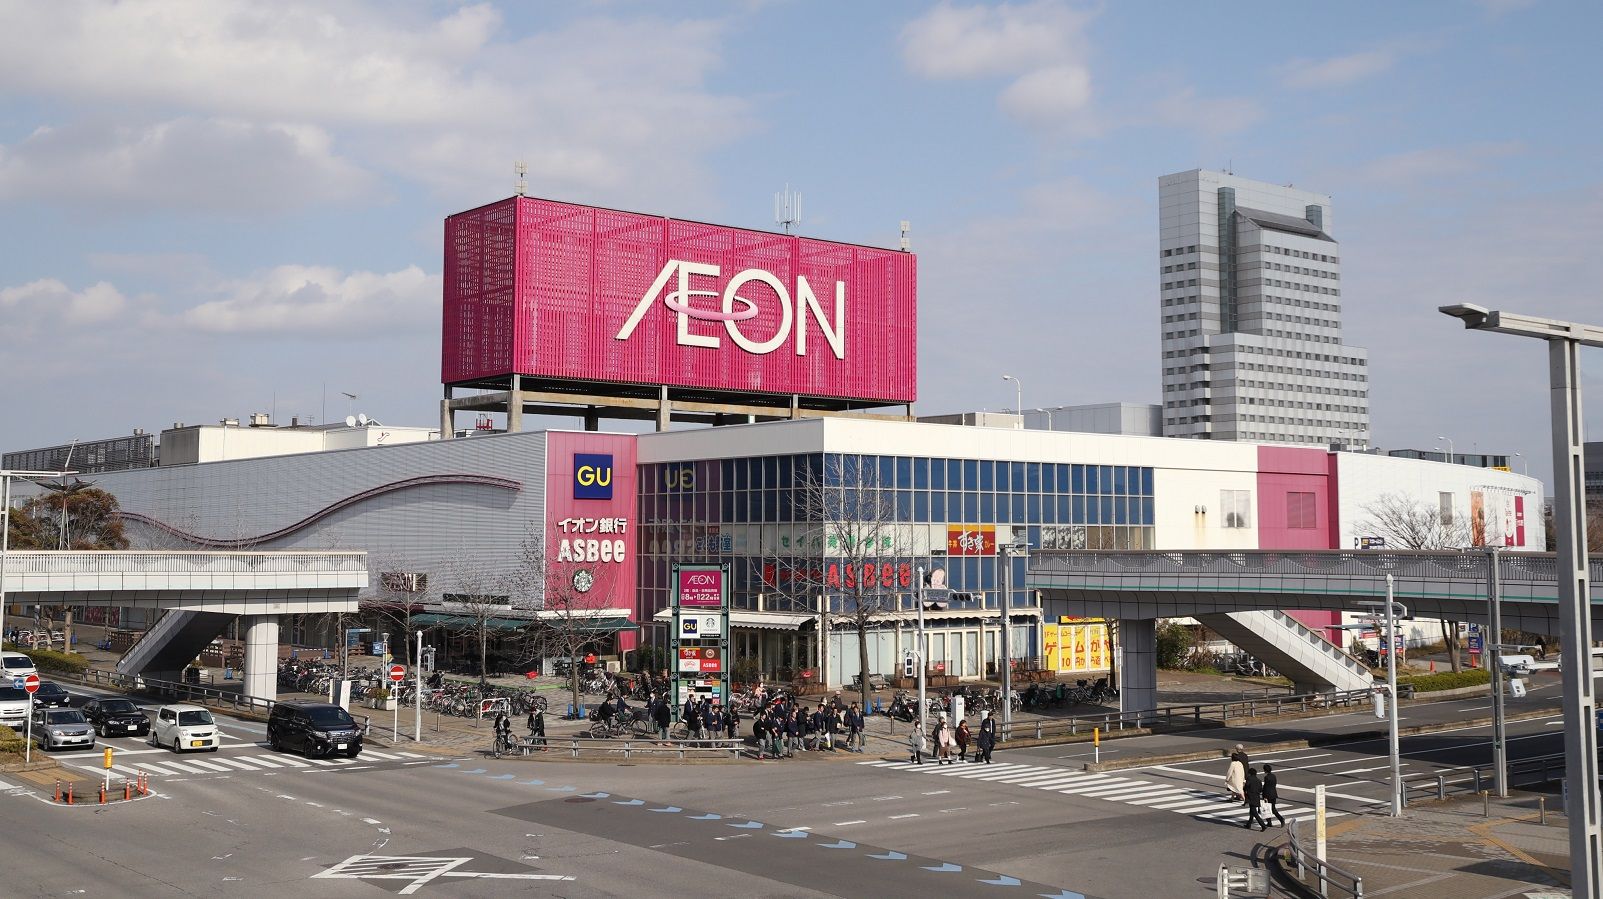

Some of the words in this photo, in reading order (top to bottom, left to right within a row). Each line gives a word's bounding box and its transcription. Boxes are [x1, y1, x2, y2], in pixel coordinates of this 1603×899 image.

[577, 465, 611, 487] GU
[558, 517, 627, 534] イオン銀行
[557, 539, 626, 563] ASBee
[683, 622, 697, 631] GU
